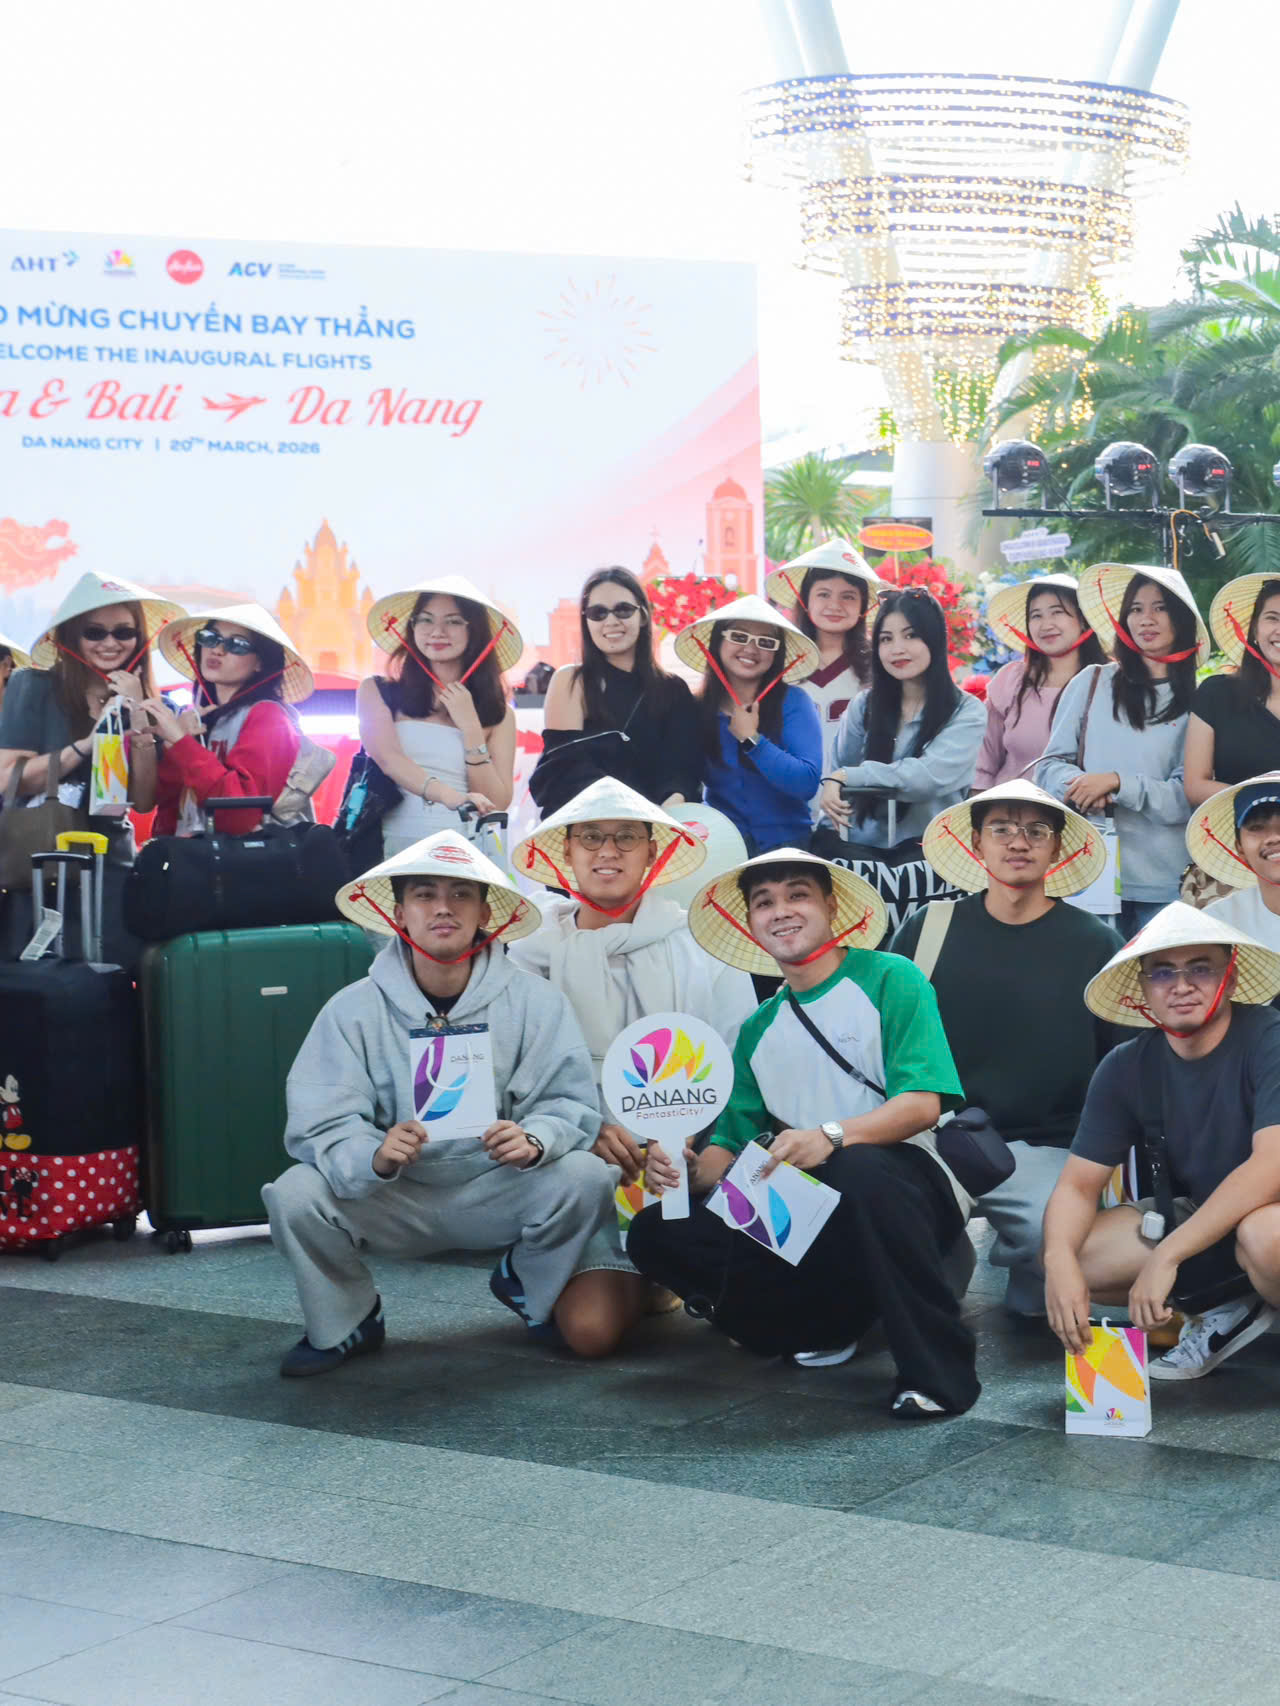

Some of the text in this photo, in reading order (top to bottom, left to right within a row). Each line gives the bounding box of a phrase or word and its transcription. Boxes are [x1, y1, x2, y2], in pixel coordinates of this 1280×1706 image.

[227, 262, 272, 278] ACV
[18, 300, 111, 329] MỪNG
[119, 301, 243, 334] CHUYẾN
[251, 314, 309, 336] BAY
[95, 346, 138, 364] THE
[145, 348, 277, 369] INAUGURAL
[283, 352, 373, 371] FLIGHTS
[29, 378, 71, 420] &
[85, 379, 184, 422] Bali
[288, 385, 352, 426] Da
[367, 387, 484, 438] Nang
[22, 434, 48, 449] DA
[51, 436, 102, 450] NANG
[104, 437, 145, 451] CITY
[622, 1088, 717, 1113] DANANG
